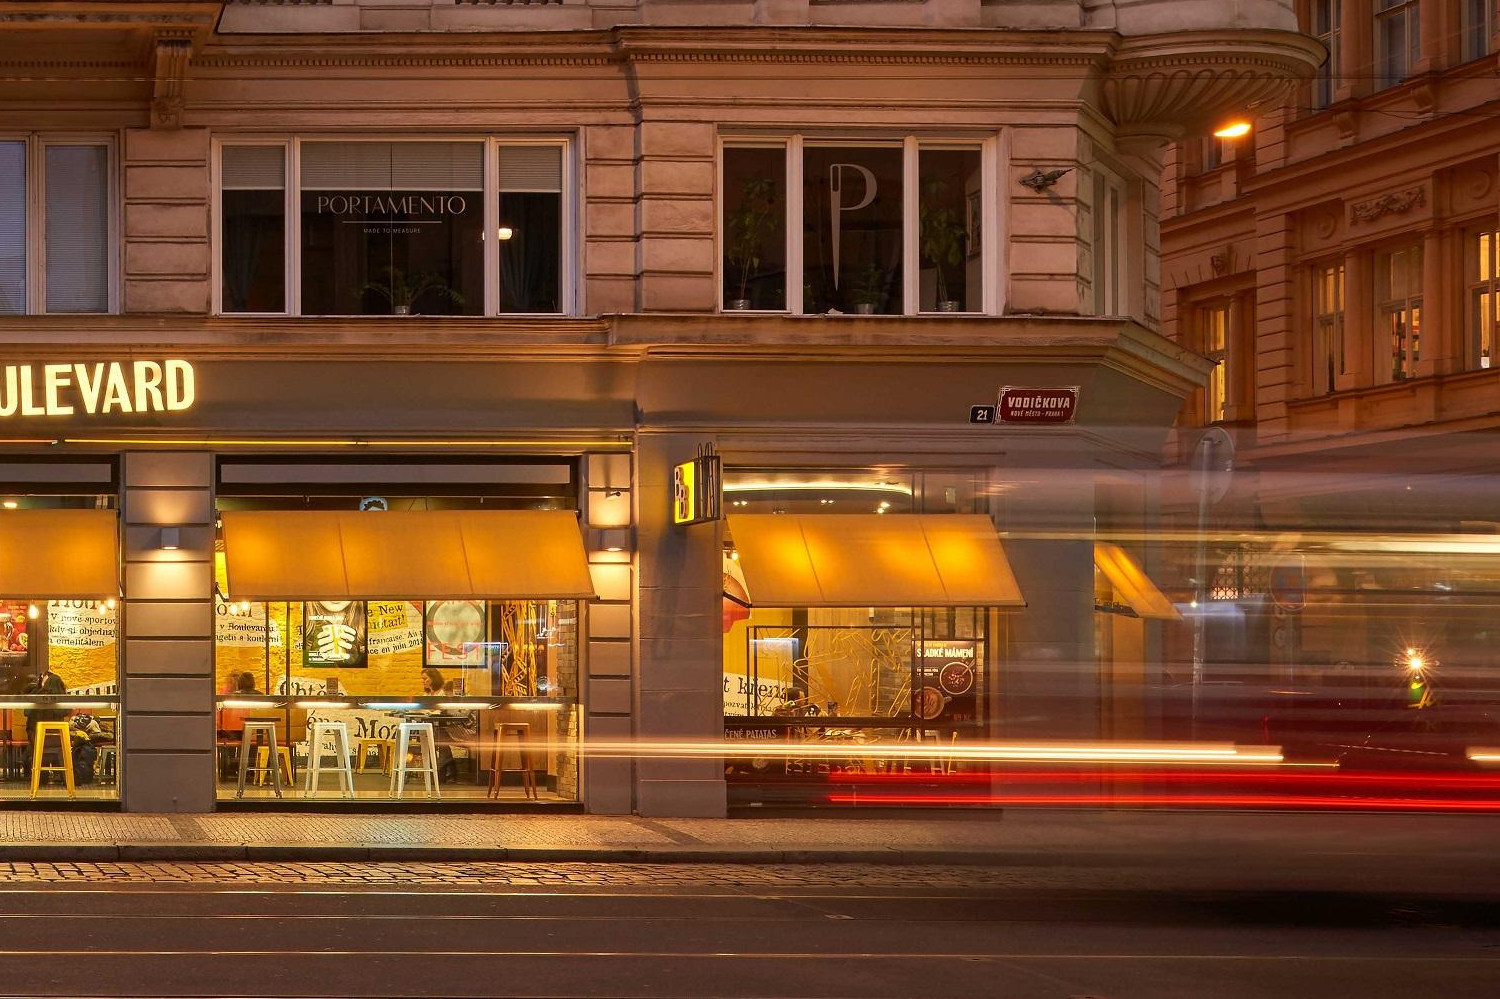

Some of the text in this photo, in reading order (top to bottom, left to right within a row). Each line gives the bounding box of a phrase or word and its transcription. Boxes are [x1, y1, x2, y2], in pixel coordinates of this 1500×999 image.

[318, 195, 466, 215] PORTAMENTO
[1008, 396, 1070, 409] VODIČKOVA
[977, 409, 988, 421] 21
[378, 604, 404, 616] New
[426, 642, 481, 661] FEST
[916, 647, 944, 658] SADKÉ
[746, 729, 777, 739] PATATAS
